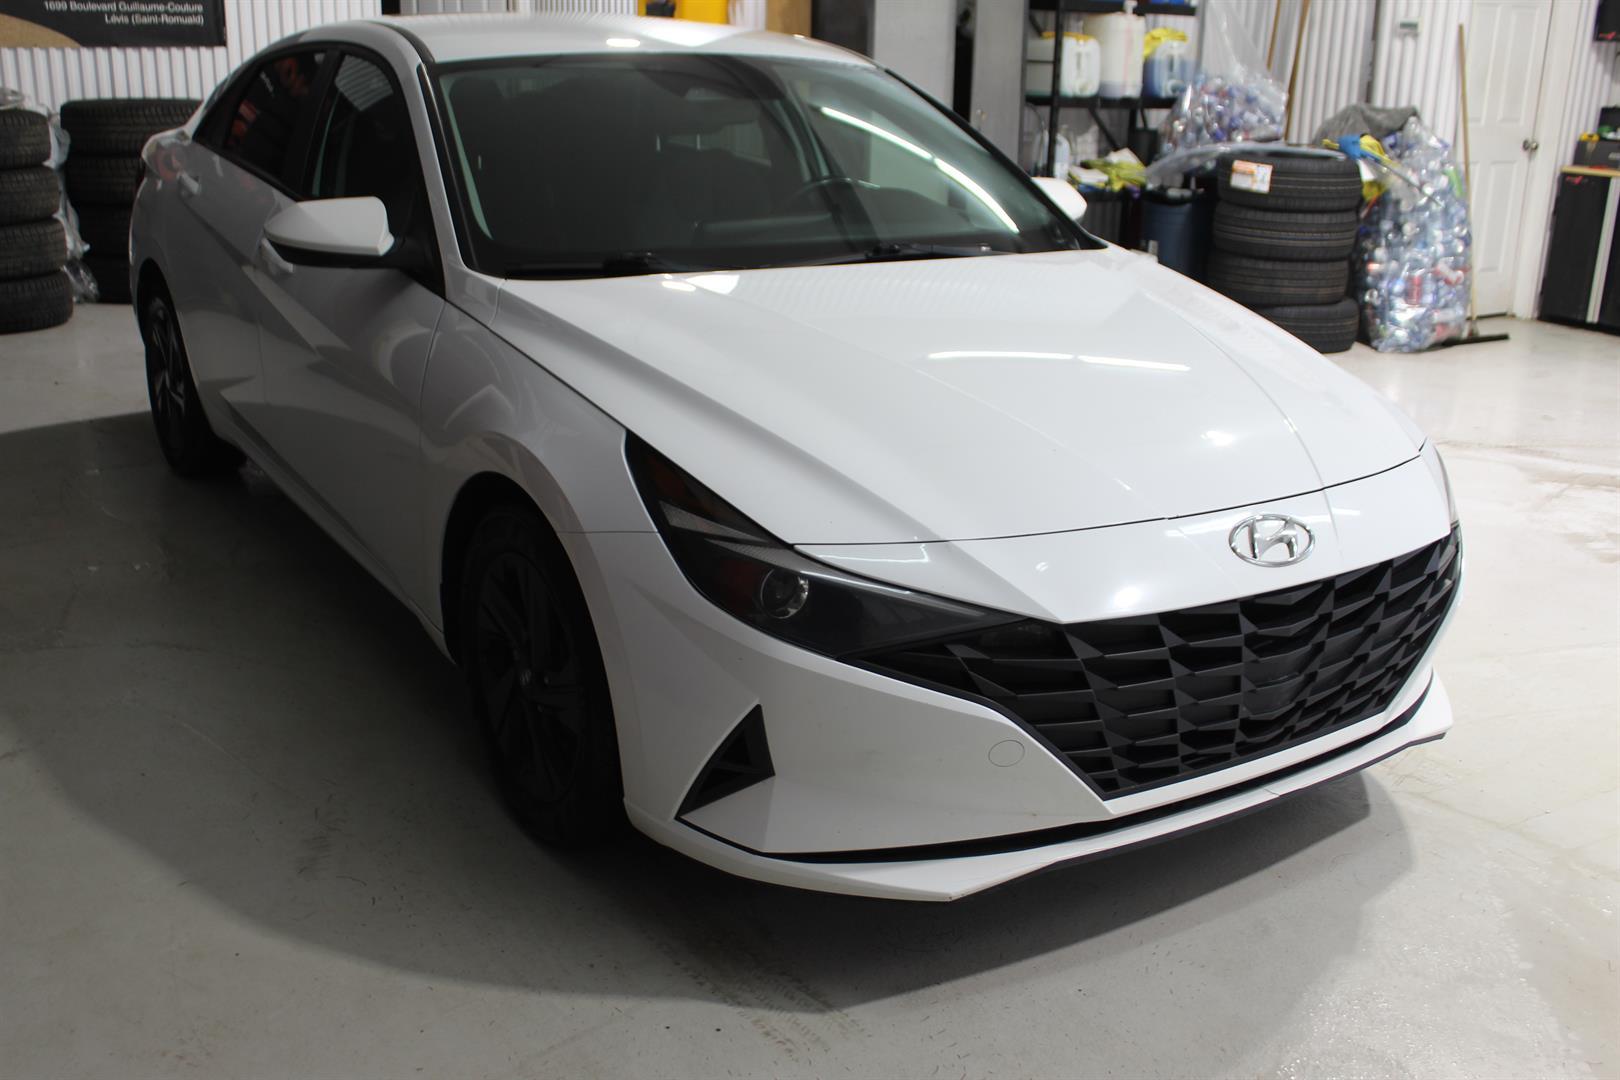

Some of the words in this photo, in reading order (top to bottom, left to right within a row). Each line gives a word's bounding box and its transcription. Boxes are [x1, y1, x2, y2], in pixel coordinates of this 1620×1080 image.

[70, 1, 117, 12] Boulevard
[119, 1, 204, 12] Guillaume-Couture
[132, 14, 204, 25] (Saint-Romuald)
